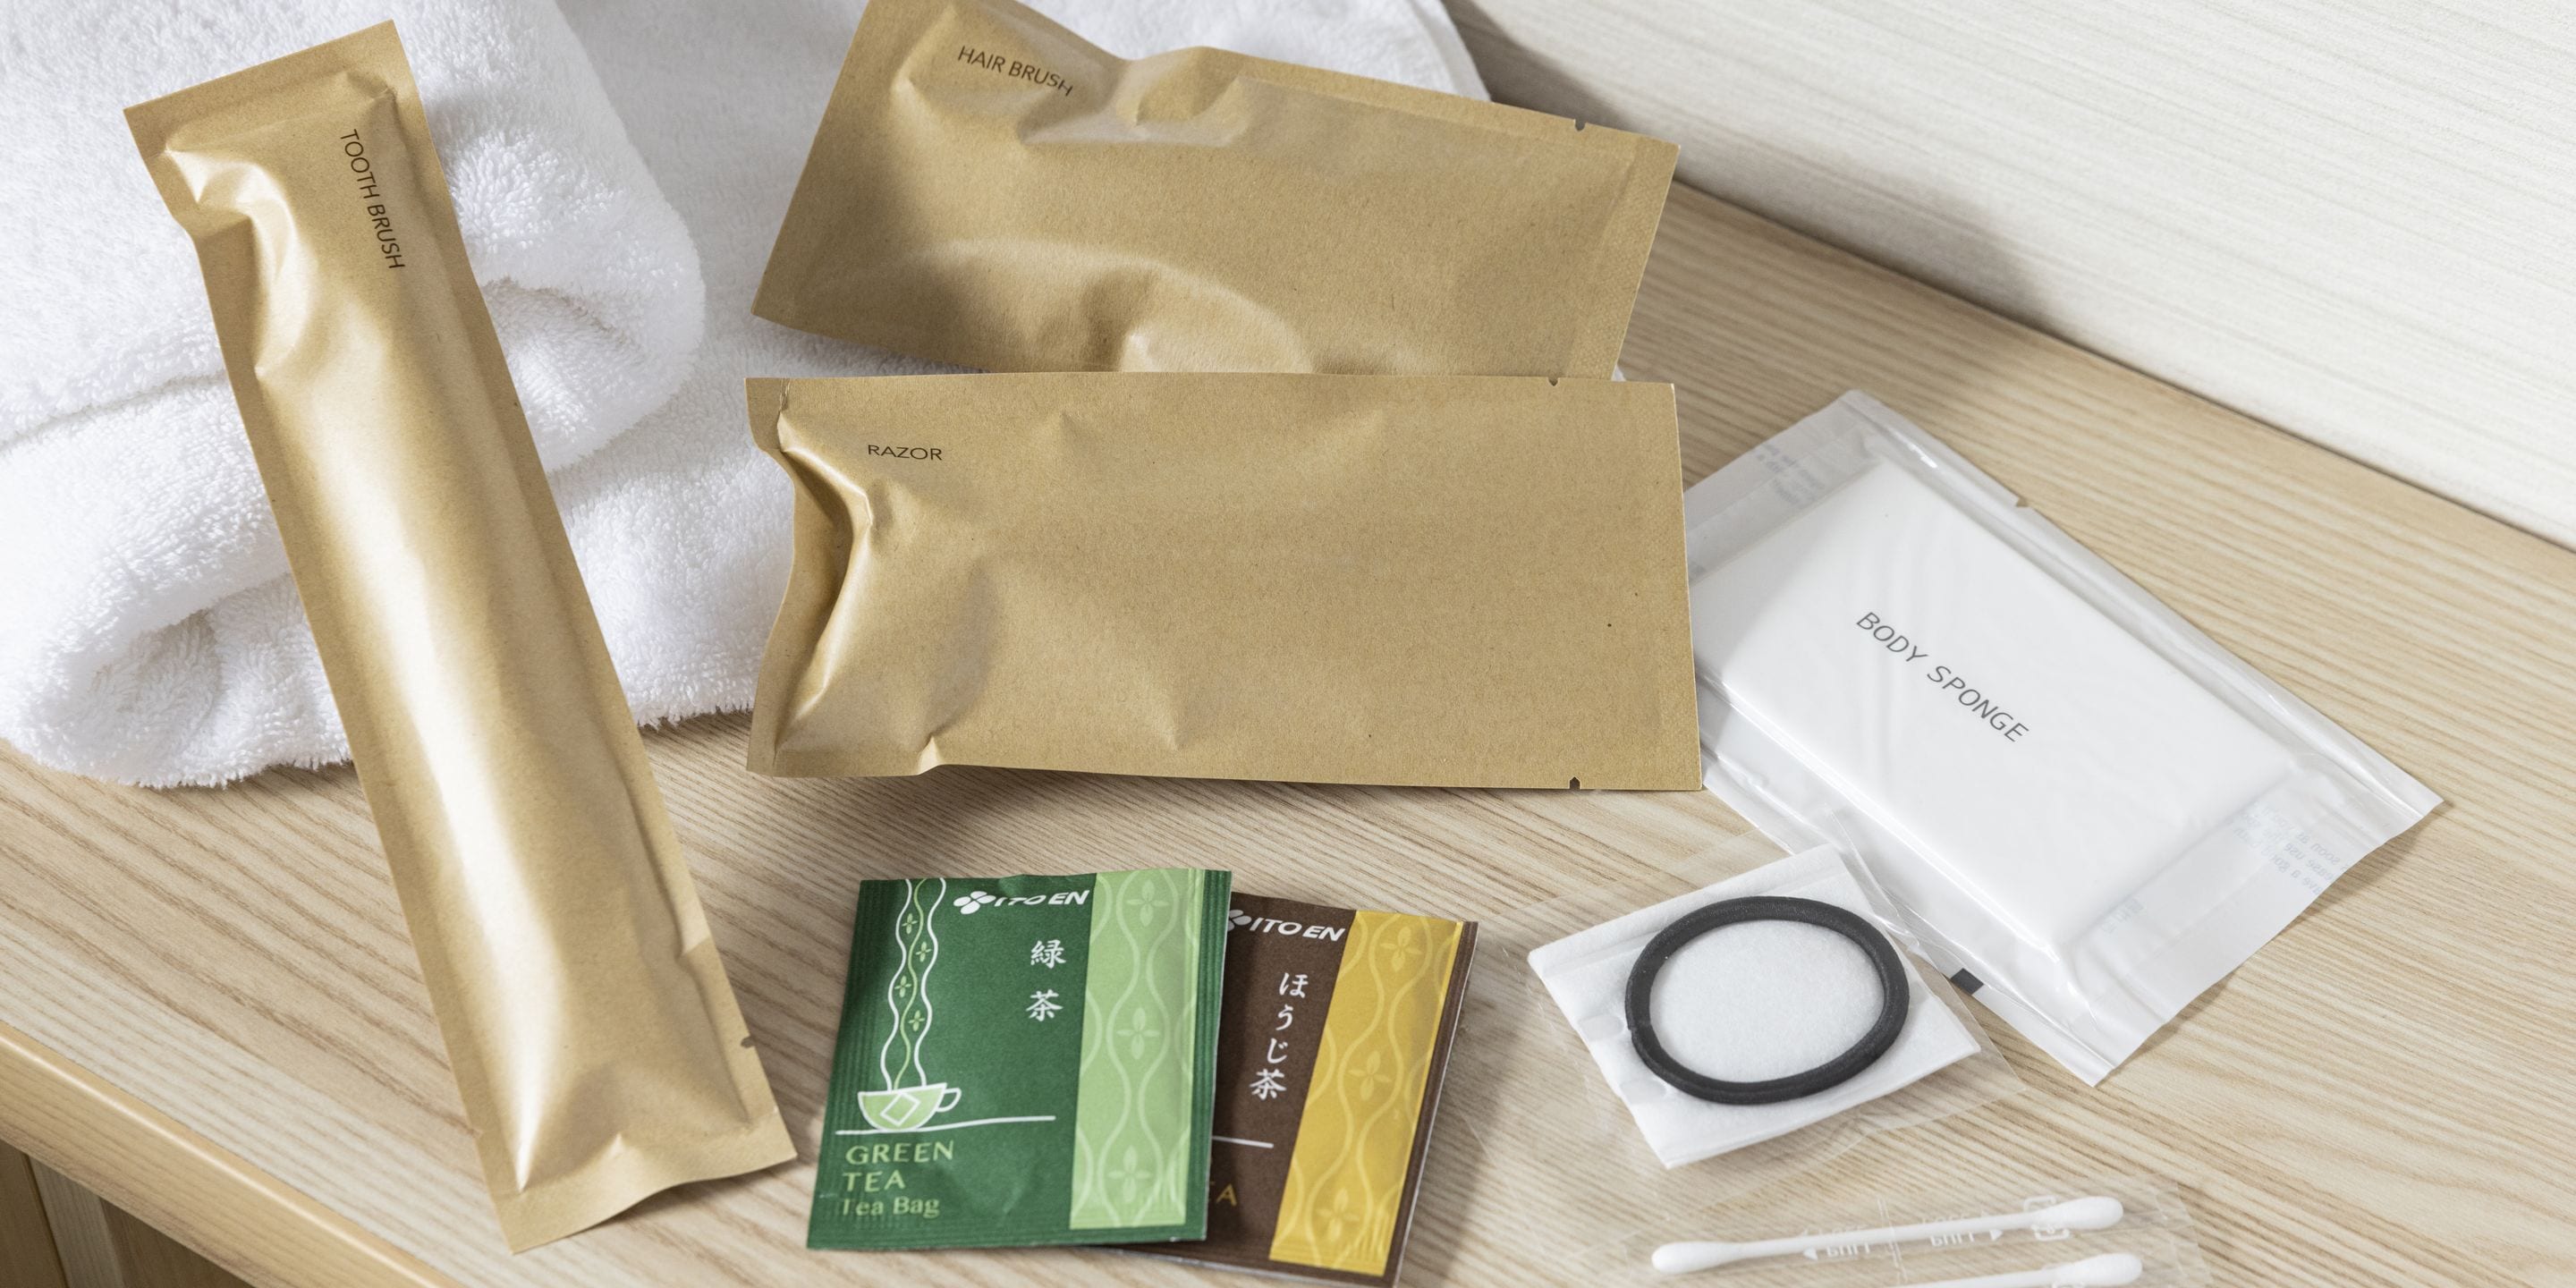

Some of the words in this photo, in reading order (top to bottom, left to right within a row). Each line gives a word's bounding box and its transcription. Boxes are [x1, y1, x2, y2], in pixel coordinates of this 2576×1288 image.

[958, 46, 1005, 73] HAIR
[1008, 61, 1073, 97] BRUSH
[340, 129, 380, 199] TOOTH
[367, 204, 405, 268] BRUSH
[868, 444, 943, 461] RAZOR
[1856, 612, 1929, 662] BODY
[1927, 665, 2029, 742] SPONGE
[1026, 939, 1066, 1021] 緑茶
[1250, 972, 1309, 1100] ほうじ茶
[845, 1140, 954, 1165] GREEN
[843, 1170, 906, 1192] TEA
[893, 1196, 939, 1218] Bag
